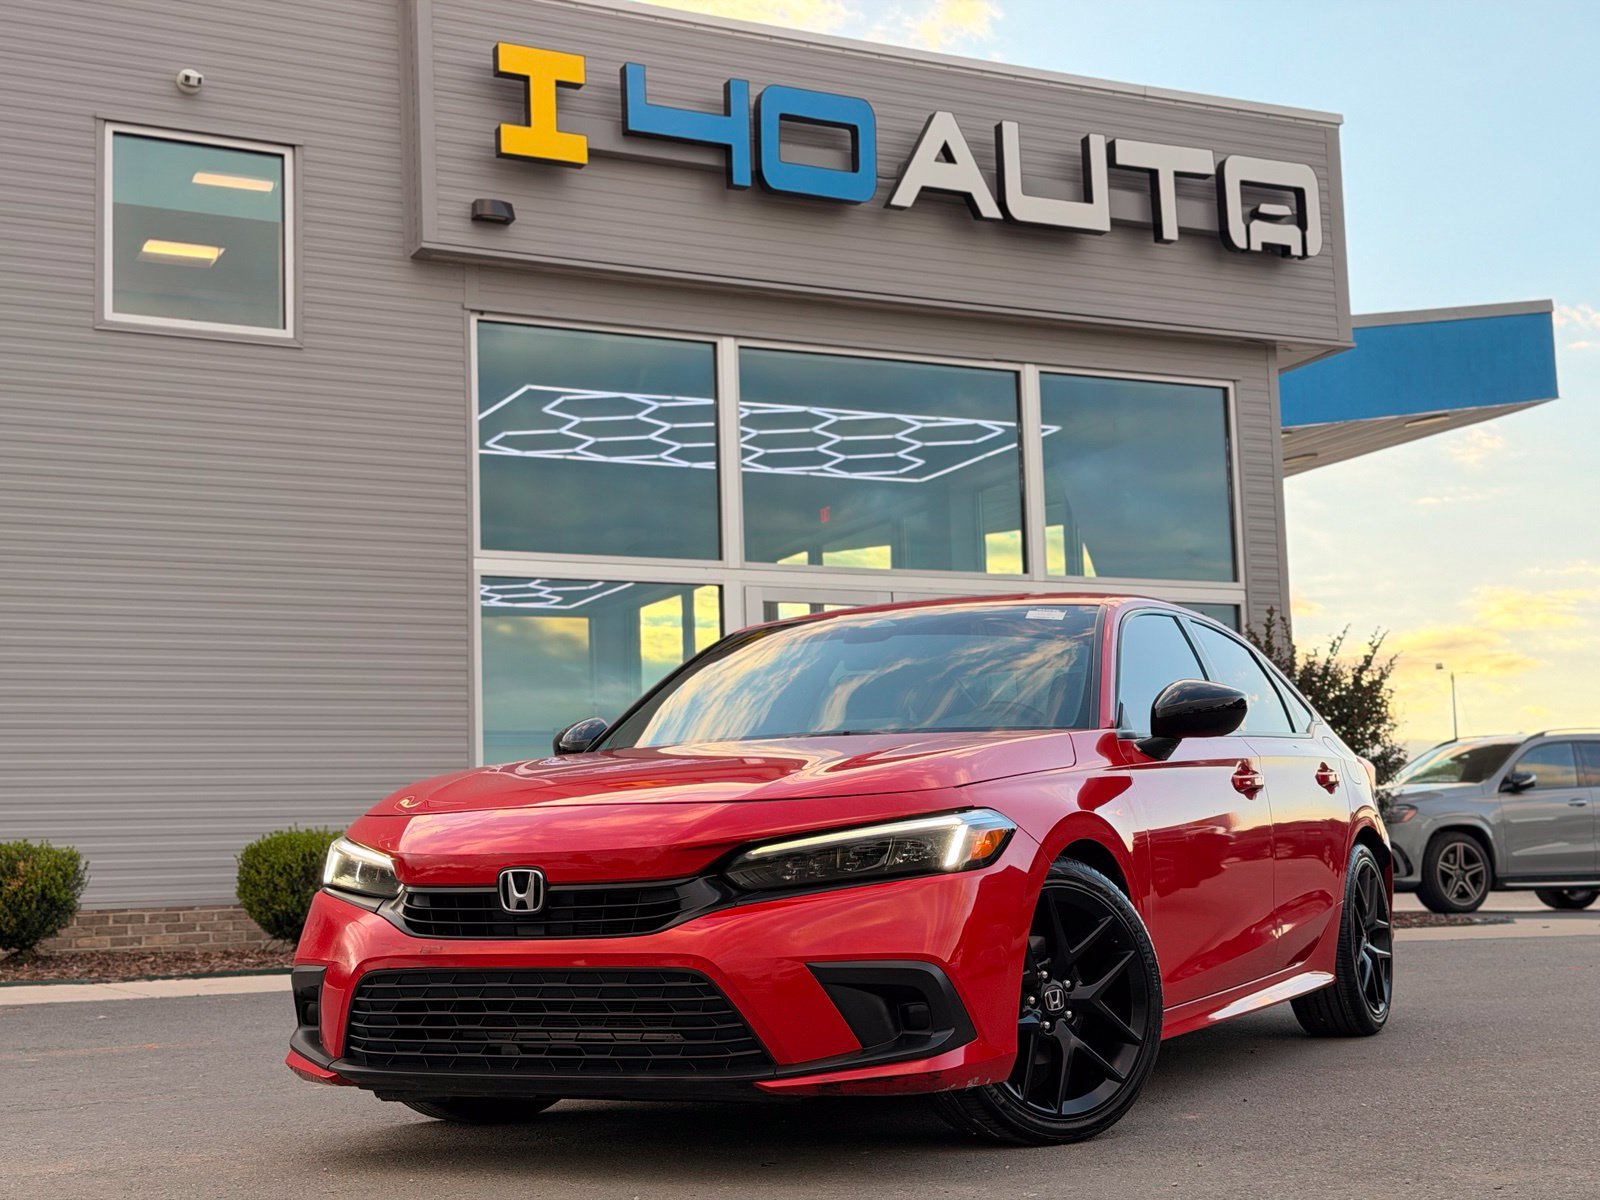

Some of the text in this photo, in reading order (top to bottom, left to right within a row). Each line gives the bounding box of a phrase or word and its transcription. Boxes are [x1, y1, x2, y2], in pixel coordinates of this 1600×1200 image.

[494, 42, 588, 167] I
[621, 62, 877, 203] 40
[506, 870, 537, 911] H
